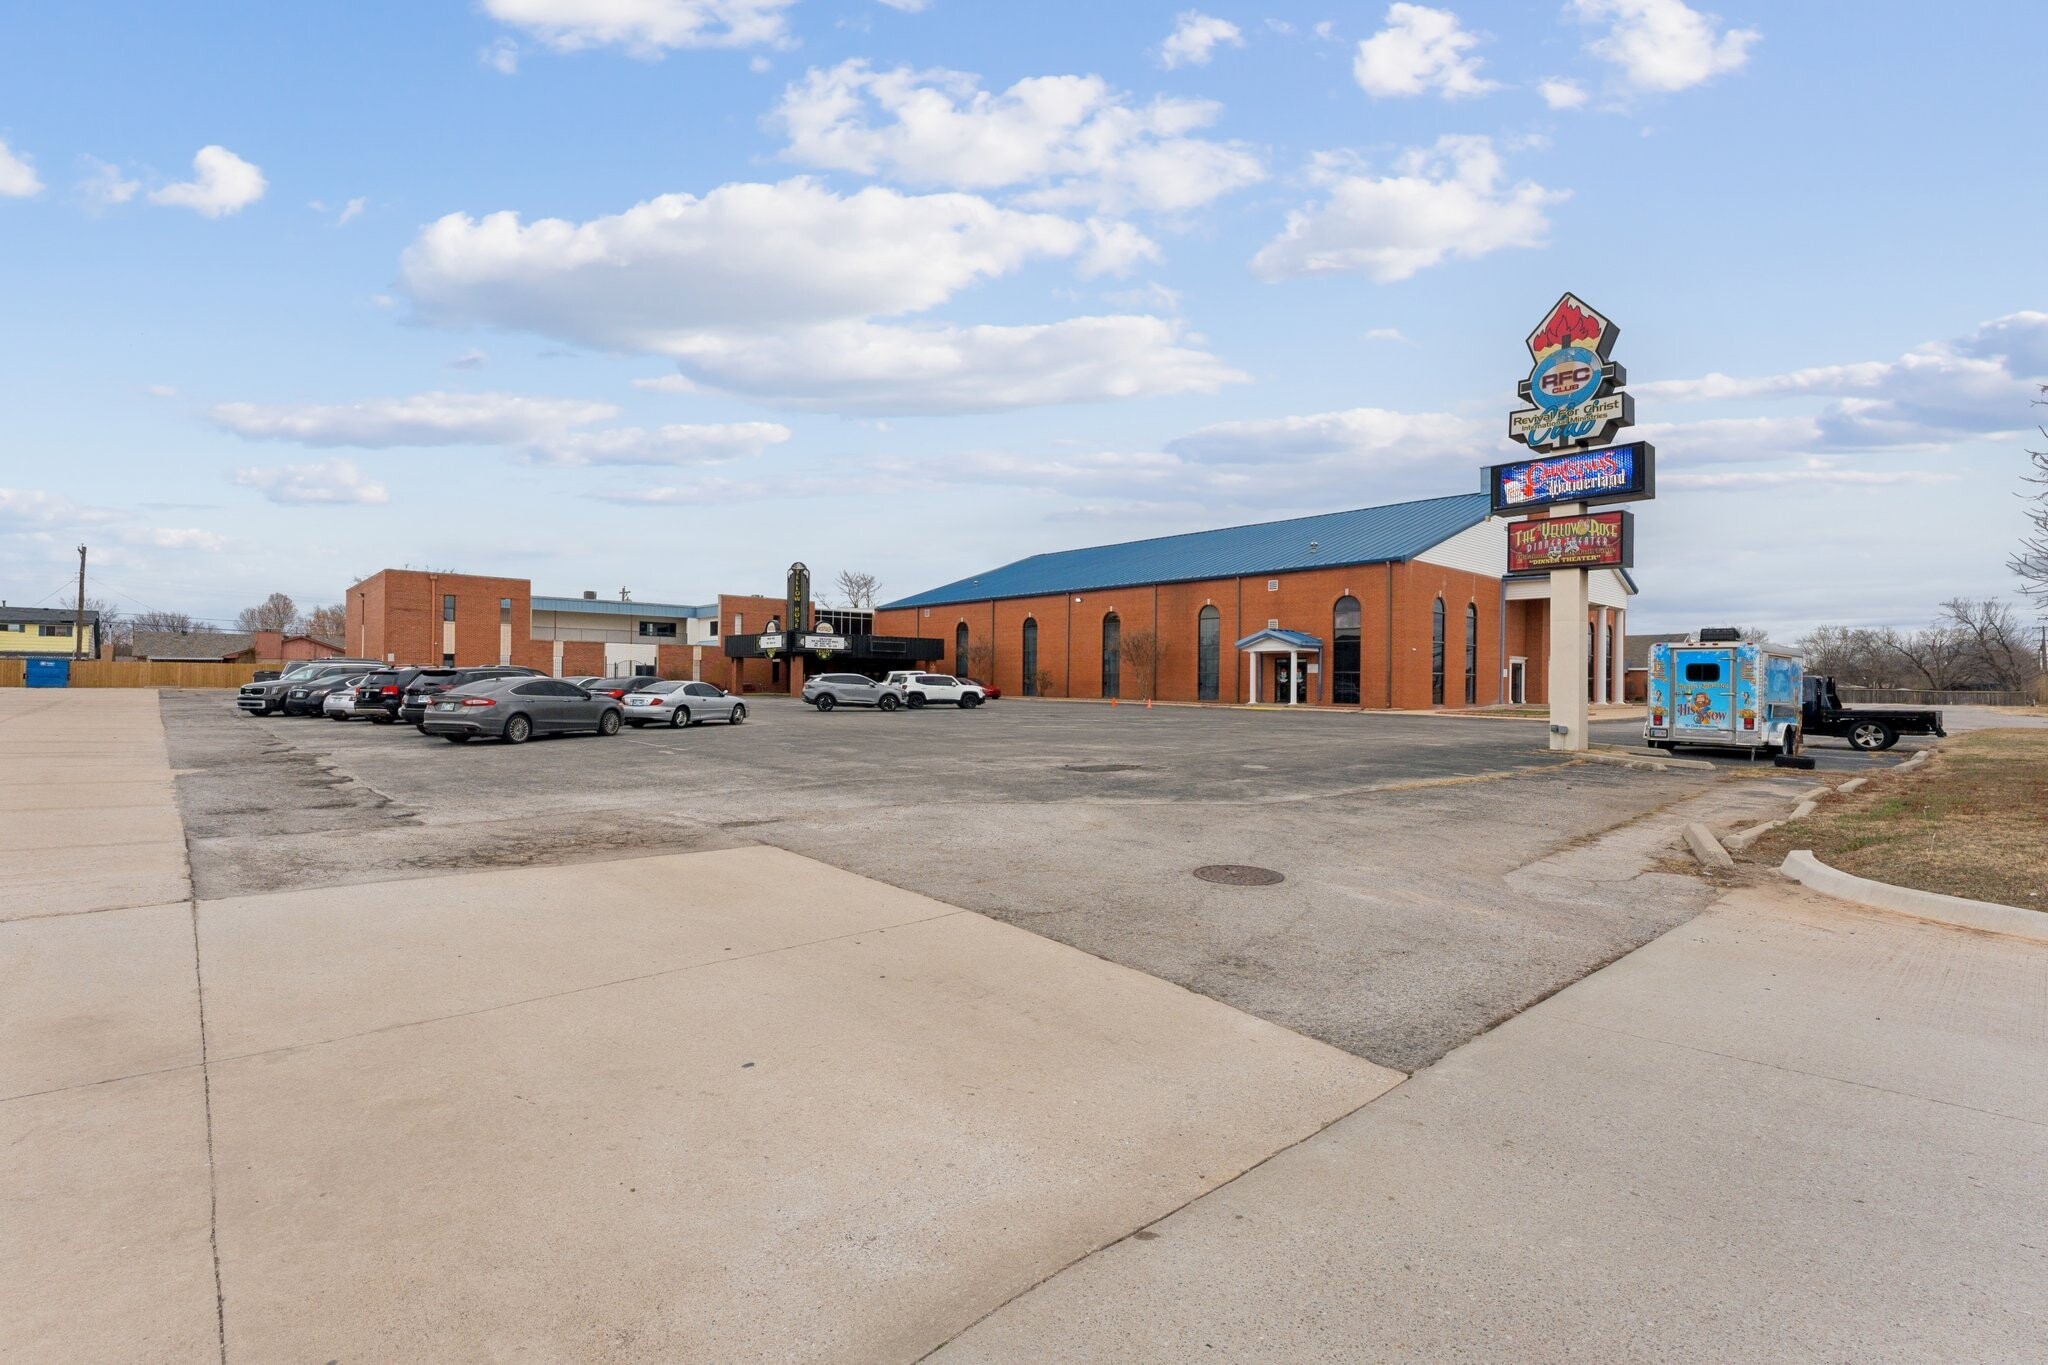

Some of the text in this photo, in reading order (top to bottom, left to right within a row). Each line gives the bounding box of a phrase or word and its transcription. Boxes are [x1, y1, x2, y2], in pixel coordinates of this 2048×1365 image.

[1542, 367, 1591, 389] RFC
[1551, 384, 1580, 394] CLUB
[1513, 400, 1620, 426] Revival For Christ
[1521, 412, 1608, 431] International Ministries
[1548, 468, 1626, 497] Wonderland
[1515, 518, 1618, 547] THE YELLOW ROSE
